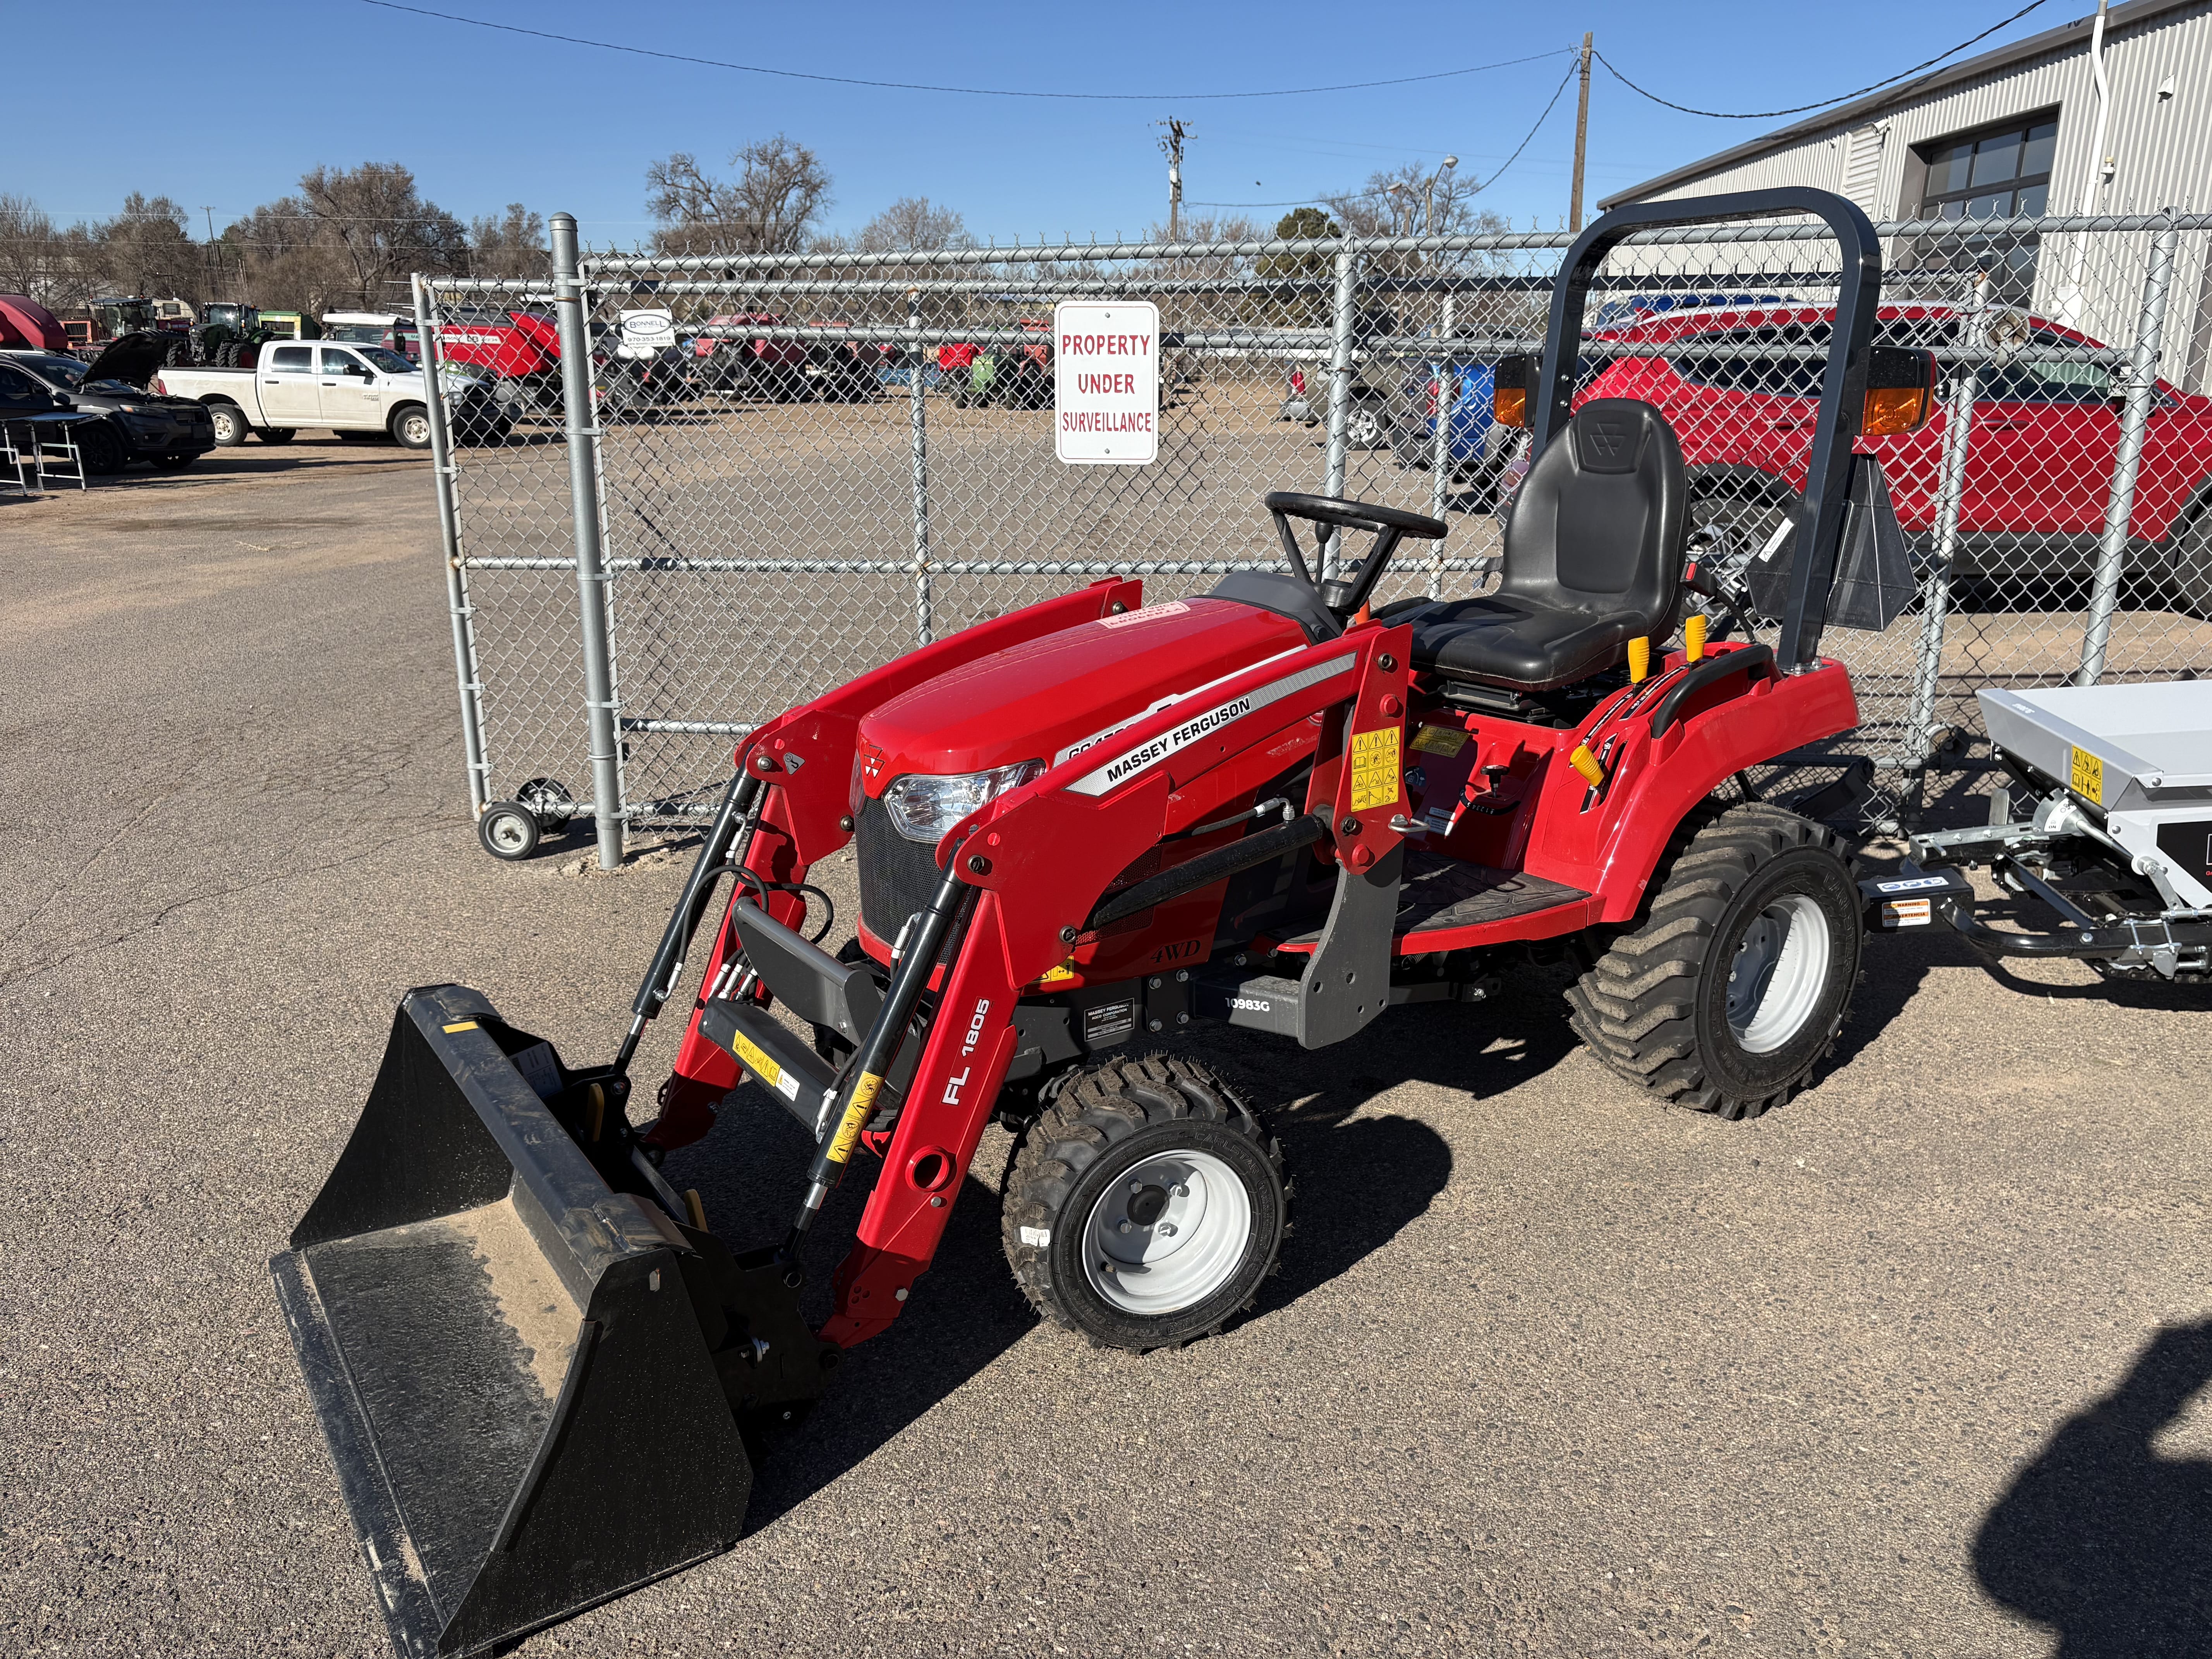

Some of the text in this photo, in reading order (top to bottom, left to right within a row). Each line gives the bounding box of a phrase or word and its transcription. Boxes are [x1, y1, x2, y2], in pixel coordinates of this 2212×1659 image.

[1063, 335, 1150, 355] PROPERTY
[1078, 374, 1135, 394] UNDER
[1063, 412, 1151, 432] SURVEILLANCE
[1107, 737, 1168, 782] MASSEY
[1173, 698, 1251, 746] FERGUSON
[1824, 873, 1855, 974] CARLSTAR
[1150, 940, 1200, 963] 4WD
[1088, 1002, 1131, 1017] MASSEY FERGUSON
[1103, 1008, 1127, 1017] CORPORATION
[1225, 998, 1270, 1012] 10983G
[942, 998, 990, 1105] FL 1805
[1195, 1132, 1261, 1175] CARLSTAR
